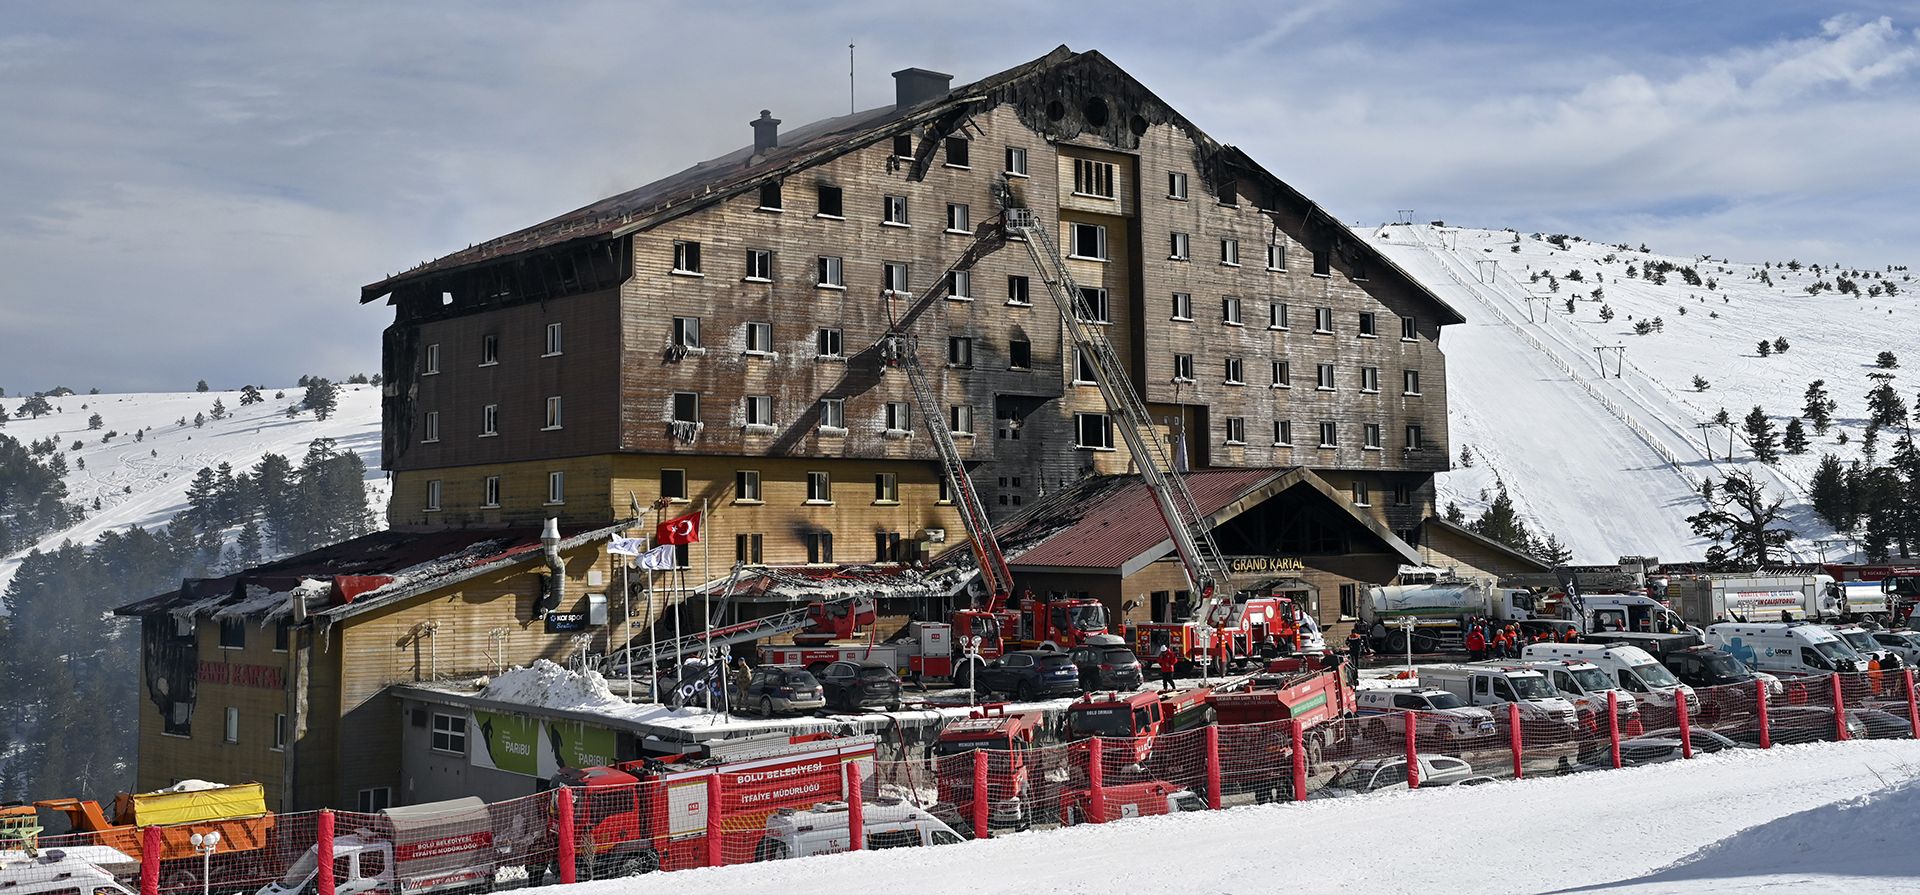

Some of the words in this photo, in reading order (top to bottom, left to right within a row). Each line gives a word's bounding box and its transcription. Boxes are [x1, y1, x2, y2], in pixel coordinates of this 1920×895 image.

[1233, 558, 1267, 571] GRAND
[1269, 557, 1305, 570] KARTAL
[737, 773, 764, 784] BOLU
[766, 761, 822, 779] BELEDİYESİ
[741, 791, 771, 804] İTFAİYE
[773, 783, 820, 798] MÜDÜRLÜĞÜ
[828, 839, 840, 848] T.C.
